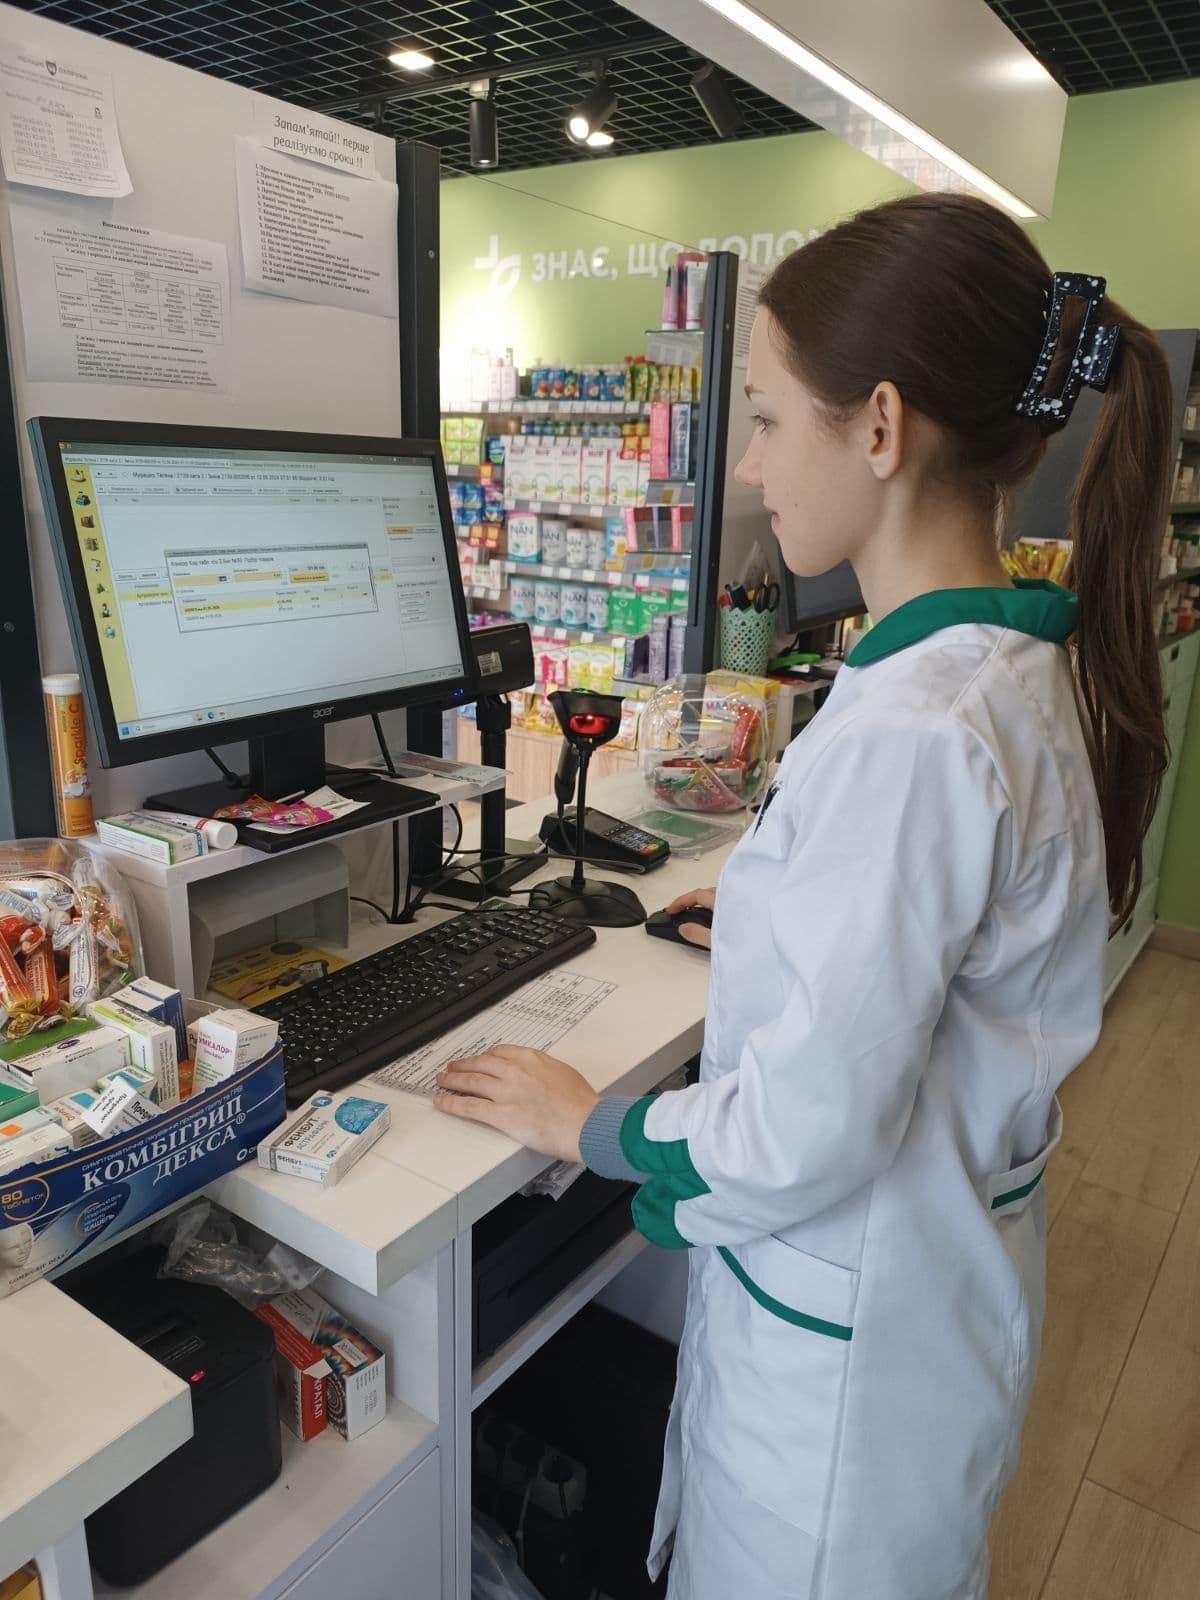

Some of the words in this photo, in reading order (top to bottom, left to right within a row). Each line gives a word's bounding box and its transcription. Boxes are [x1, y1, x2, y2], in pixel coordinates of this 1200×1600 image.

[273, 136, 327, 157] реалізуємо
[329, 150, 354, 166] сроки
[342, 138, 370, 154] перше
[312, 706, 335, 719] acer
[72, 716, 87, 766] Sparkle
[82, 1094, 243, 1193] КОМБІГРИП
[1, 1190, 23, 1203] 80
